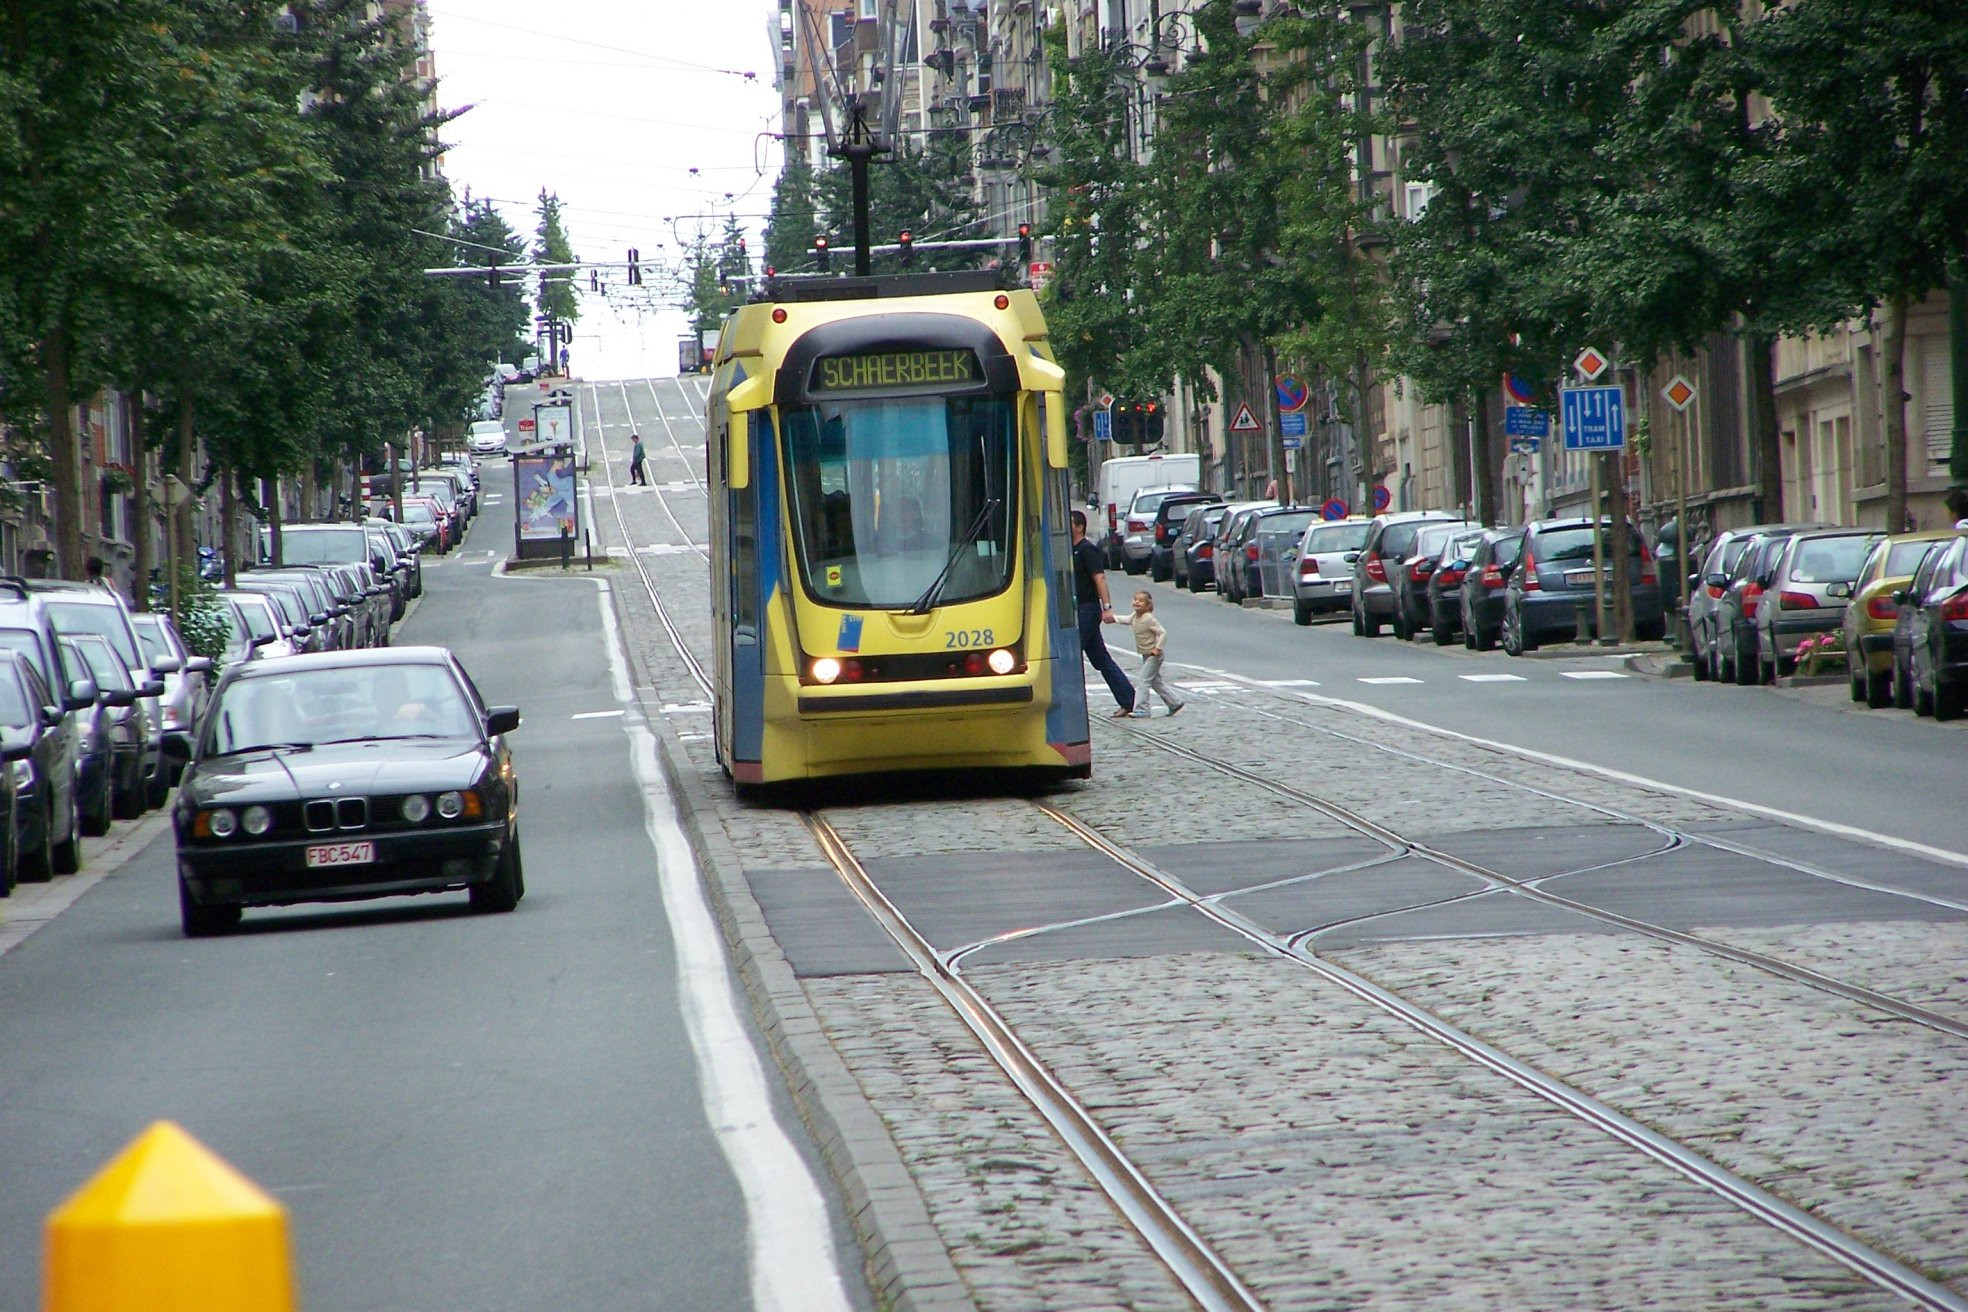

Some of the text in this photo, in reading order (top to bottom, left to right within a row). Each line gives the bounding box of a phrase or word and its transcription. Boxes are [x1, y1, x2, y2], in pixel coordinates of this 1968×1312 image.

[823, 351, 969, 387] SCHAERBEEK
[1585, 436, 1604, 444] TAXI
[945, 629, 994, 648] 2028
